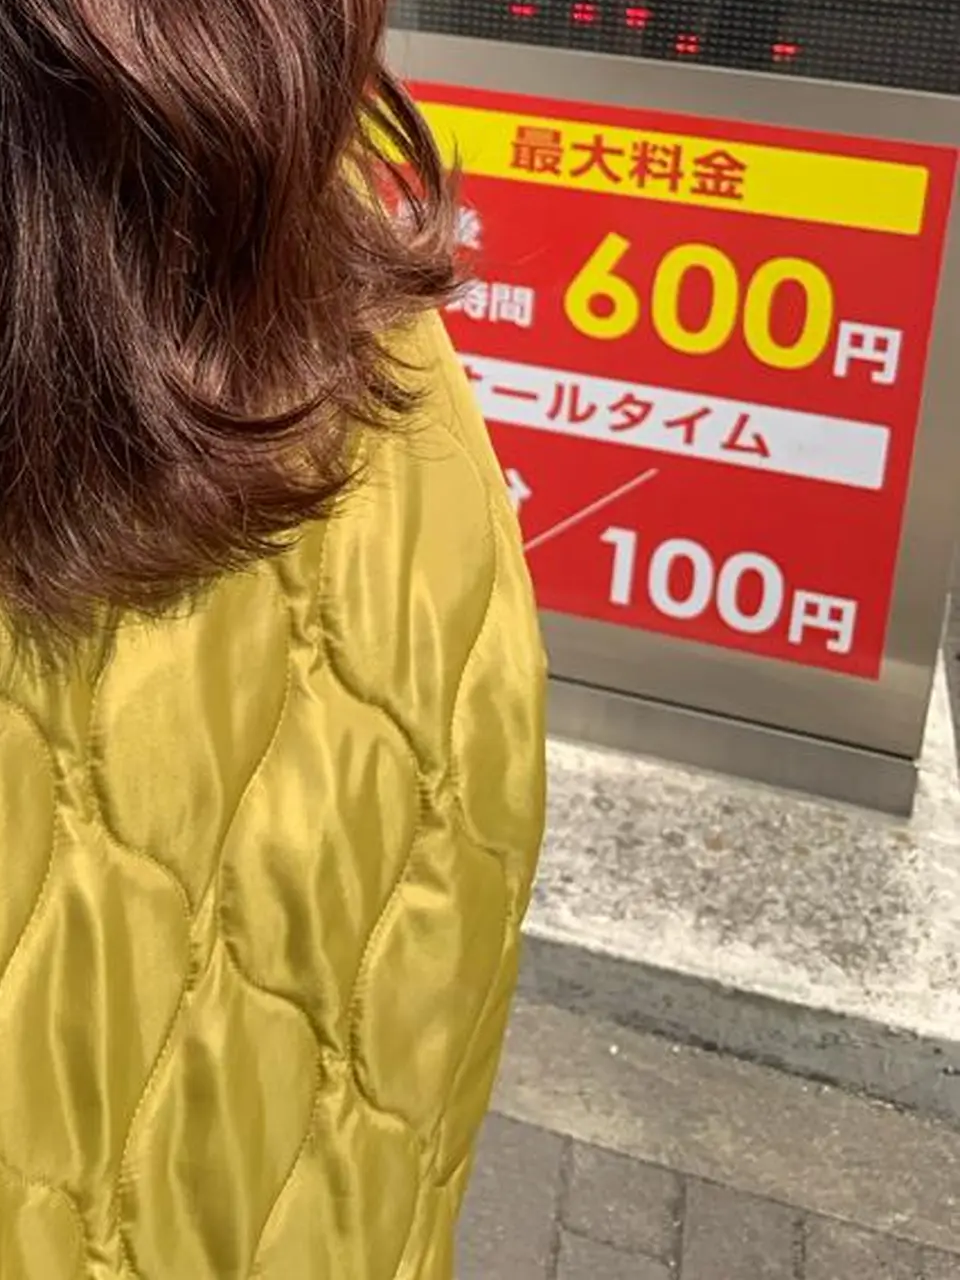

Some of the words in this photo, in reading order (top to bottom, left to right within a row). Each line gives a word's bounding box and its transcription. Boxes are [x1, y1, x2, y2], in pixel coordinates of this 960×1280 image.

[509, 125, 747, 200] 最大料金
[599, 525, 858, 654] 100円
